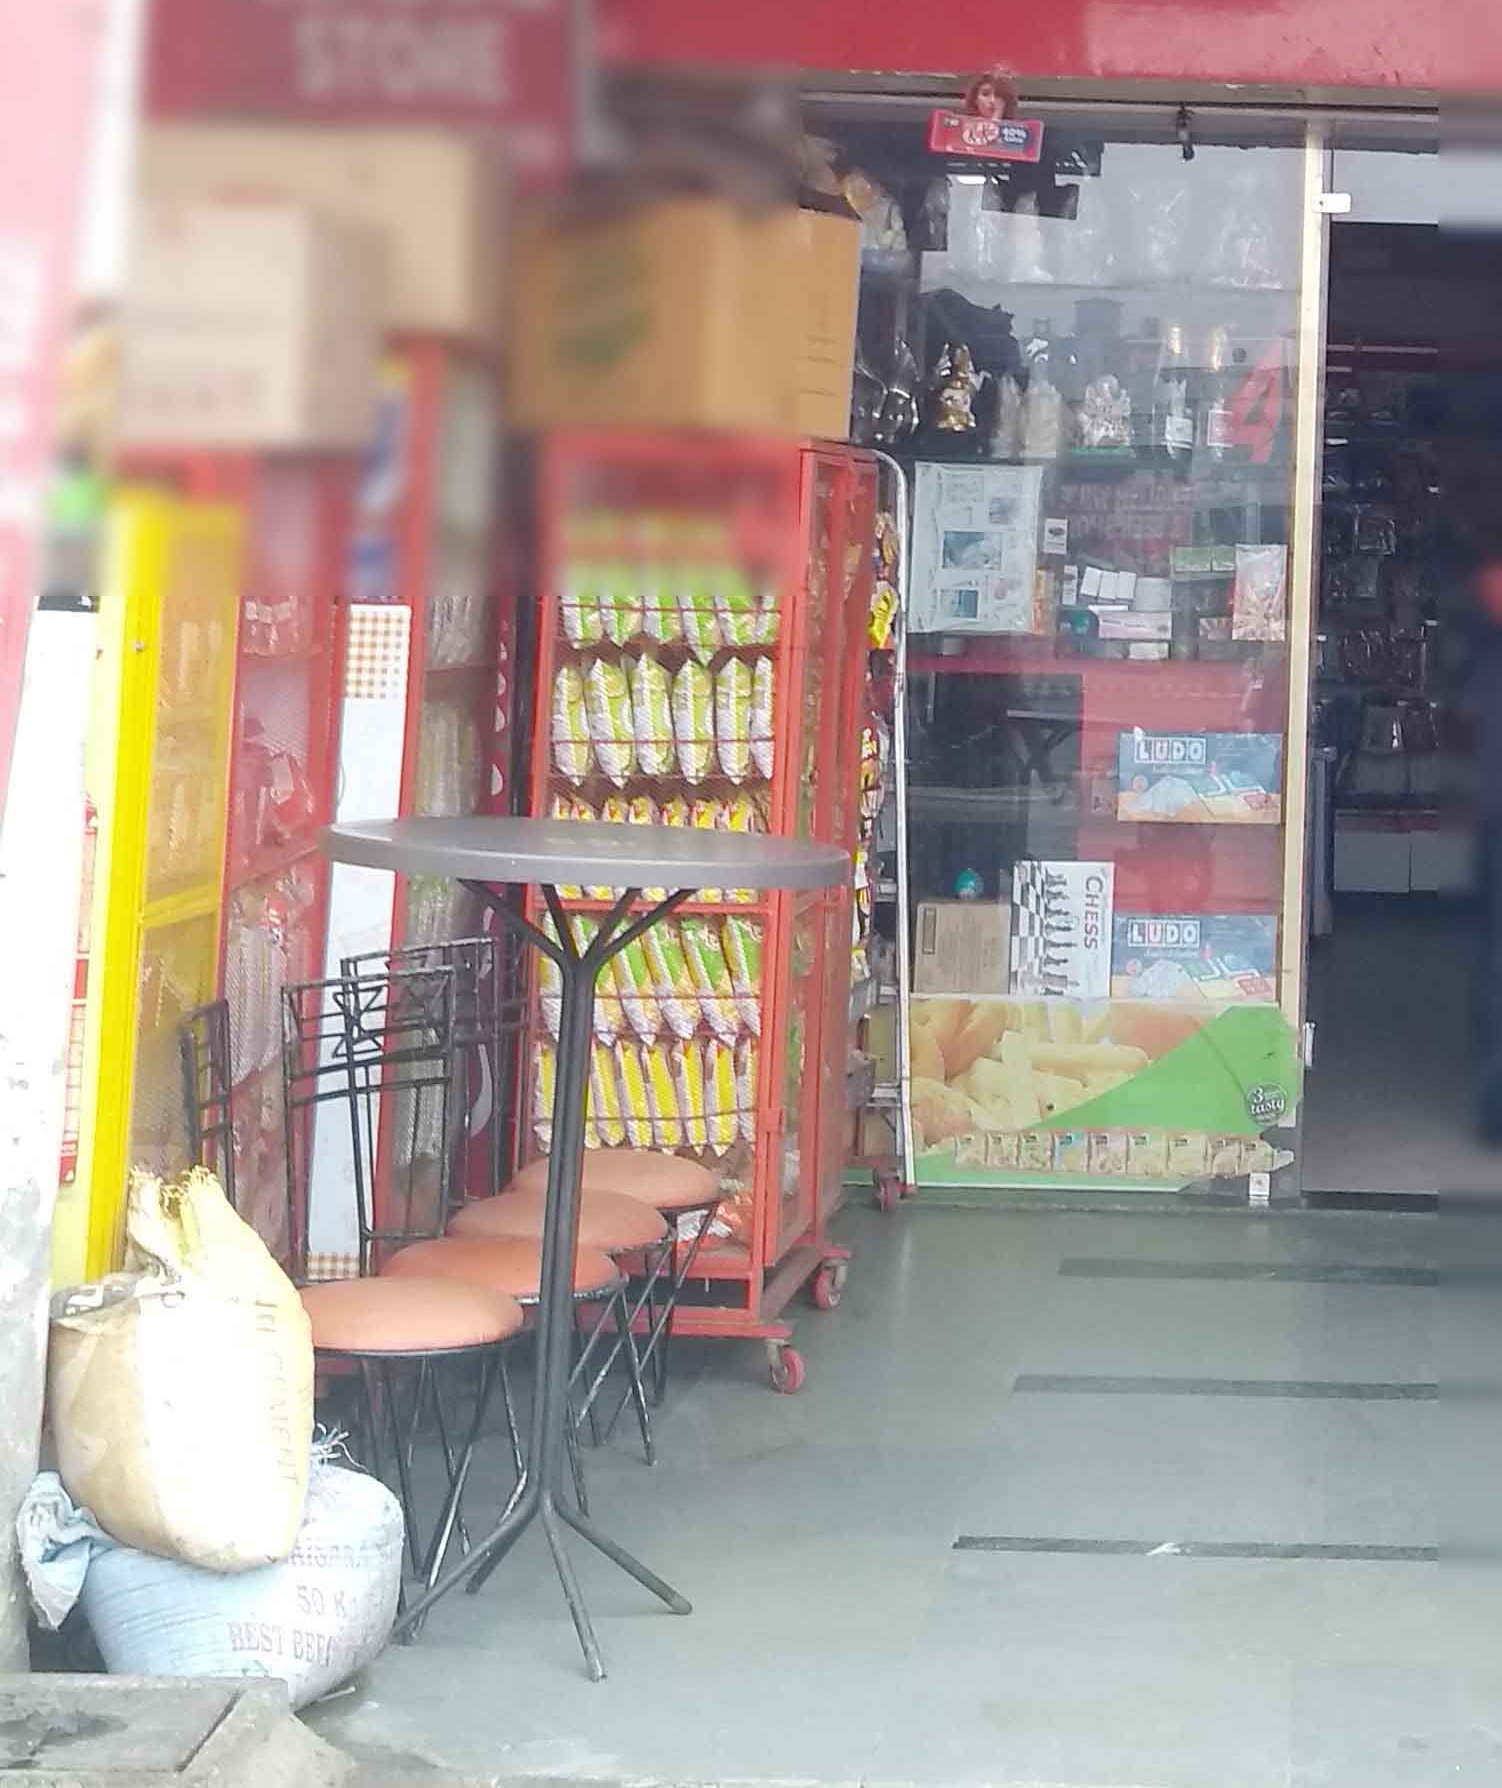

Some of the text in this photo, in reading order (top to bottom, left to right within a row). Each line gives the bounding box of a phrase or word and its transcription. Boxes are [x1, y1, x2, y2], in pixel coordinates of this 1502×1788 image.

[1136, 739, 1204, 761] LUDO
[1084, 875, 1104, 950] CHESS
[1131, 921, 1198, 944] LUDO
